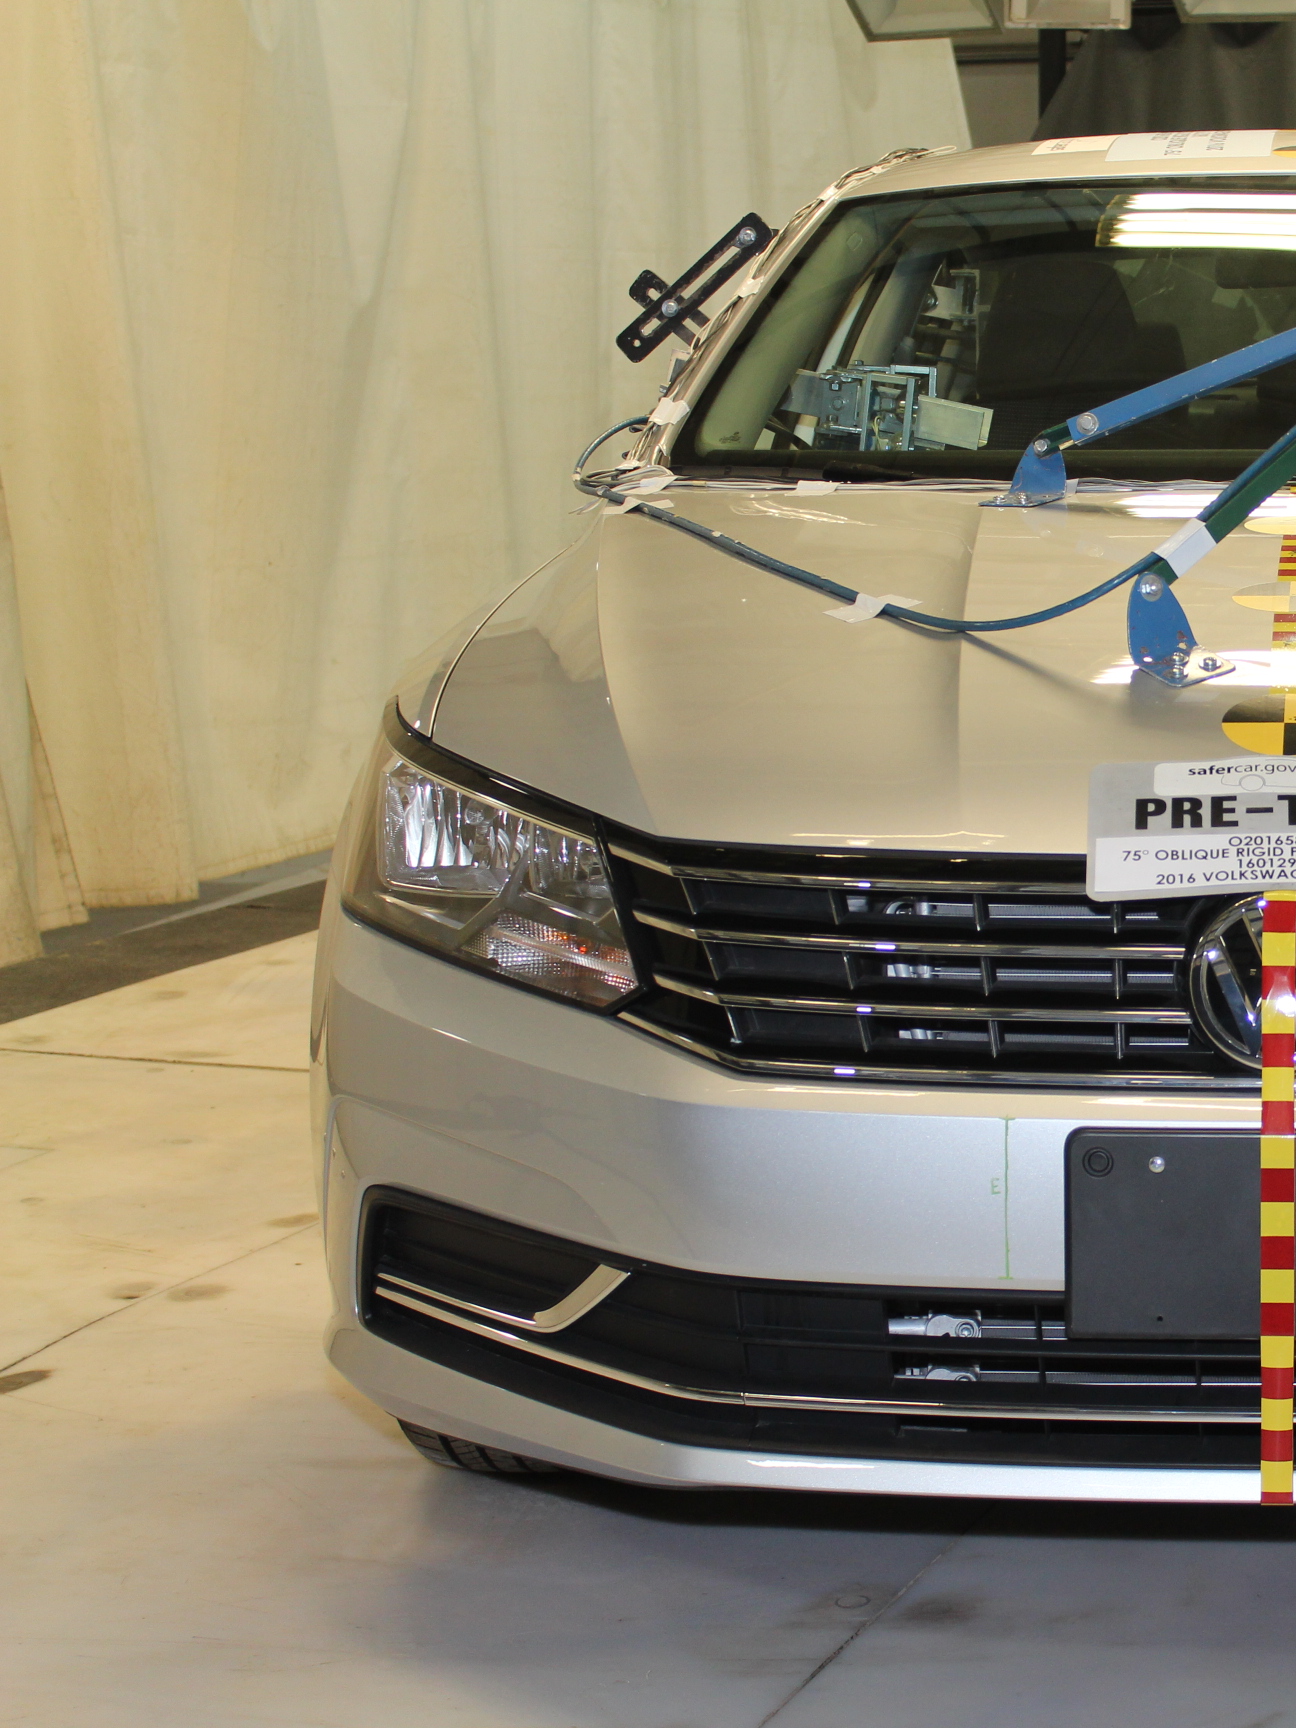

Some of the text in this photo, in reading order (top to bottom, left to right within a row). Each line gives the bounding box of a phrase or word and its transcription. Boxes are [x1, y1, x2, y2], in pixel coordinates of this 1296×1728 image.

[1154, 848, 1230, 861] OBLIQUE
[1236, 846, 1284, 858] RIGID
[1156, 873, 1196, 885] 2016
[990, 1177, 1002, 1196] E
